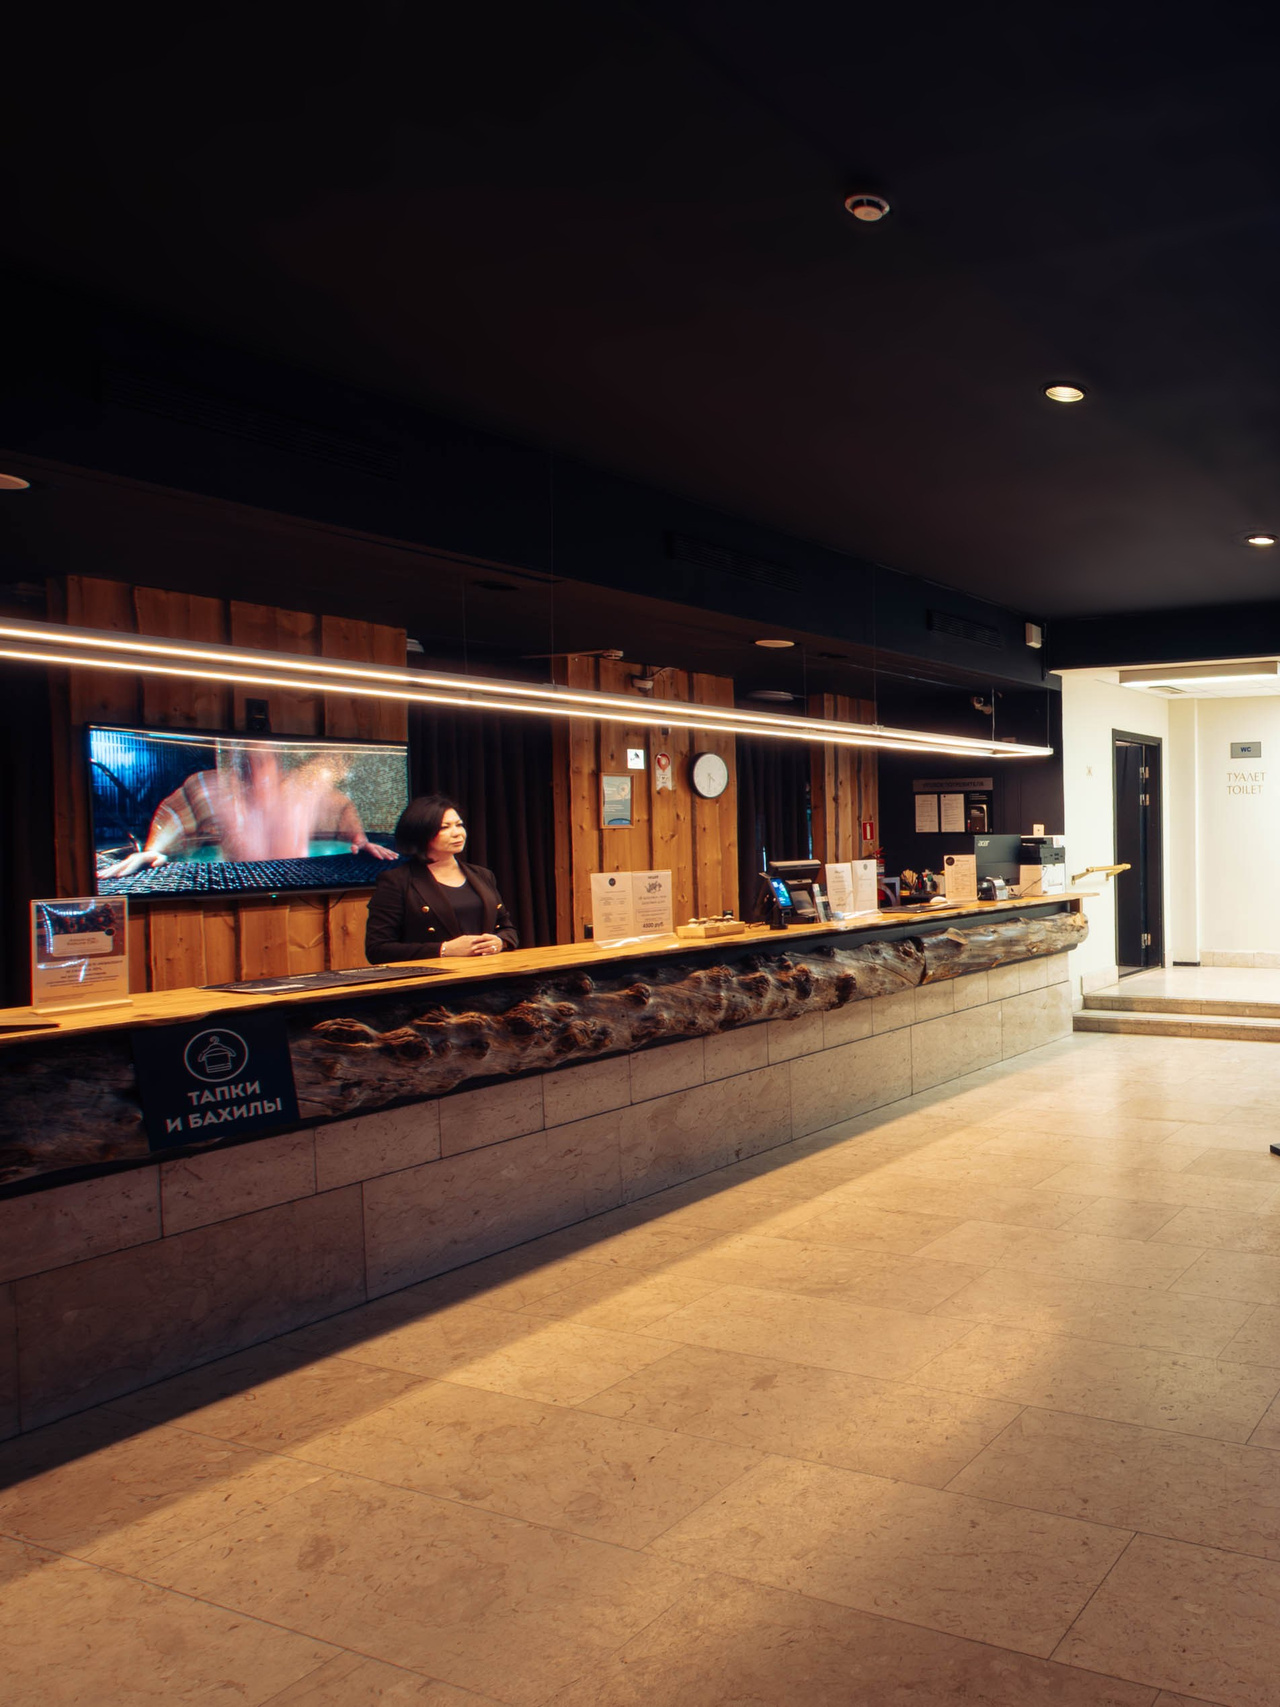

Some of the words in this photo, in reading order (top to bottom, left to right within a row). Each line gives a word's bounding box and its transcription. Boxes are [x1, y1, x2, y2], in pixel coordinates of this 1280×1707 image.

[1226, 772, 1267, 782] ТУАЛЕТ
[1226, 785, 1263, 795] TOILET
[187, 1080, 261, 1106] ТАПКИ
[166, 1117, 182, 1133] И
[188, 1097, 282, 1129] БАХИЛЫ
